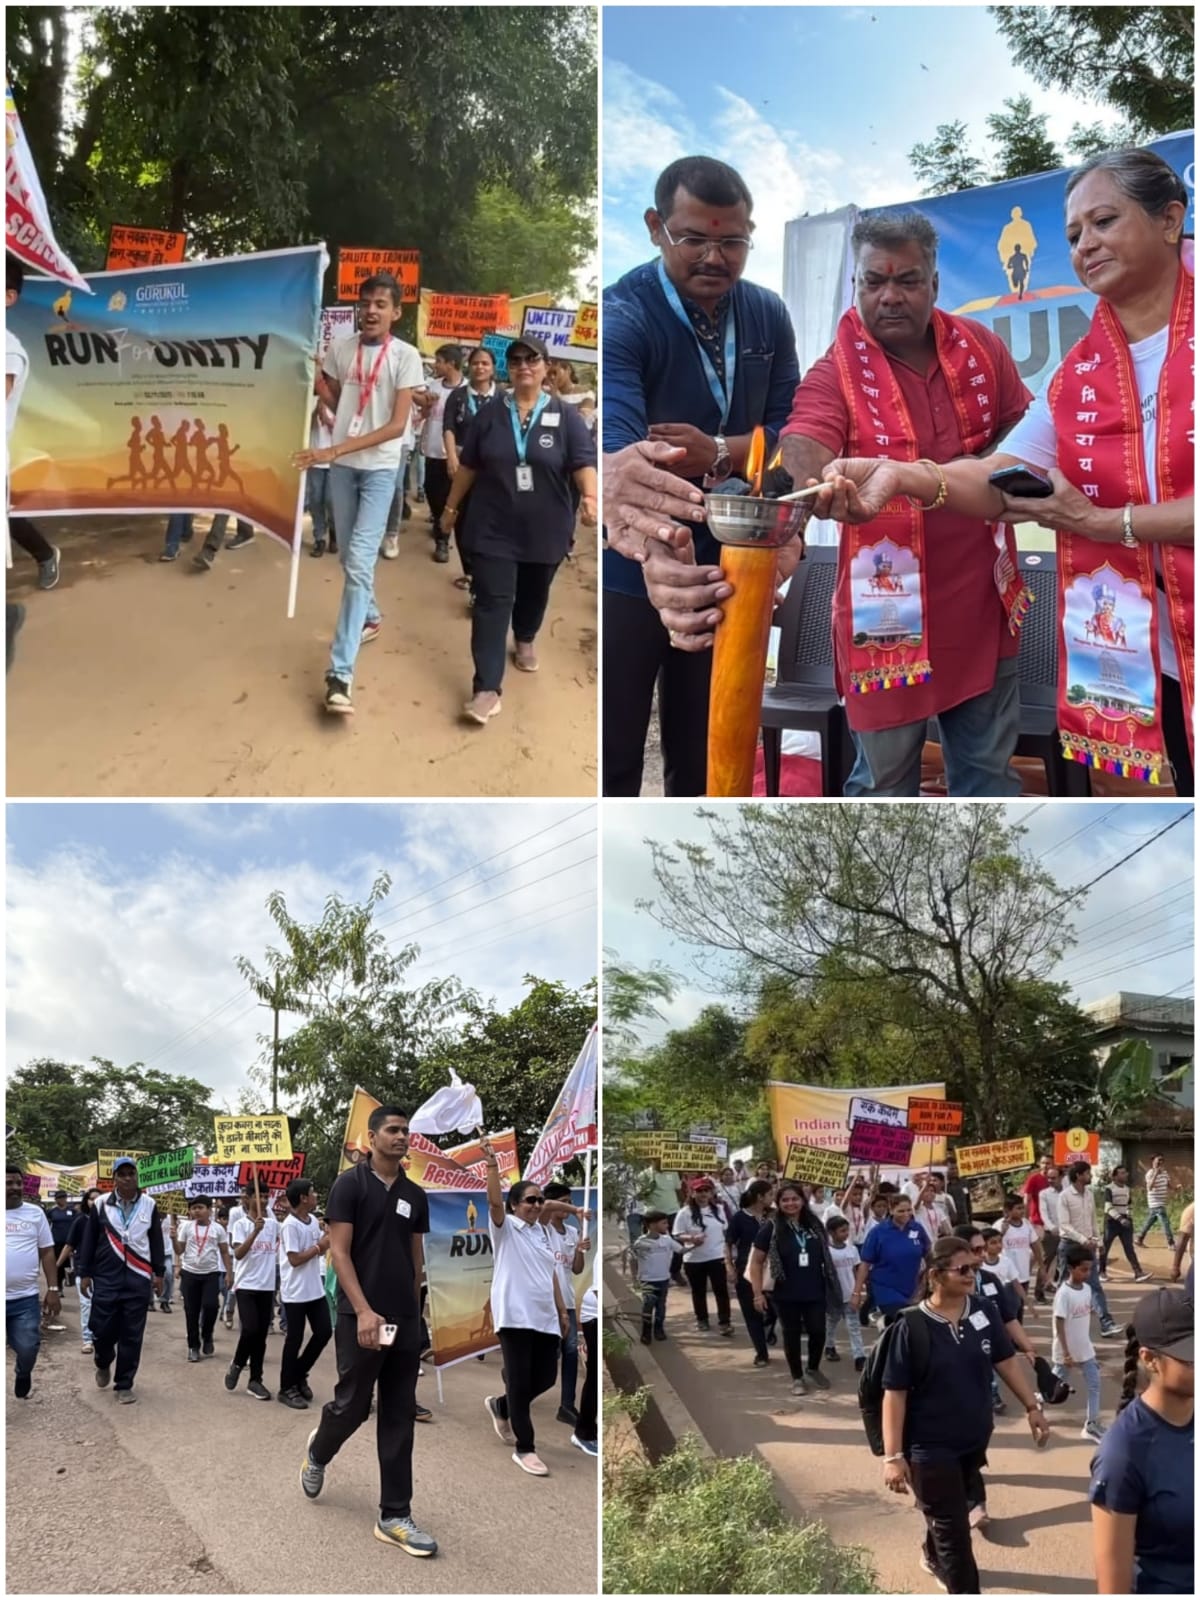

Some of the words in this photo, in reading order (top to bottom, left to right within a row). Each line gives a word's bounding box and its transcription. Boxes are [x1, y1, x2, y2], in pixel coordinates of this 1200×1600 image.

[372, 252, 382, 263] TO
[355, 266, 372, 279] RUN
[395, 267, 404, 279] A
[136, 283, 190, 303] GURUKUL
[341, 284, 360, 296] UNI
[402, 284, 417, 297] ION
[454, 309, 468, 320] FOR
[527, 310, 563, 328] UNITY
[45, 331, 119, 366] RUN
[147, 334, 270, 370] UNITY
[877, 1105, 899, 1119] कदम
[934, 1112, 946, 1120] FOR
[946, 1112, 953, 1120] A
[795, 1119, 841, 1130] Indian
[786, 1135, 851, 1147] Industria
[224, 1145, 236, 1158] तुम
[241, 1144, 250, 1154] ना
[140, 1155, 155, 1169] STEP
[158, 1153, 168, 1165] BY
[168, 1148, 188, 1163] STEP
[139, 1166, 170, 1184] TOGETHER
[246, 1166, 301, 1186] UNITY
[796, 1164, 821, 1175] UNITY
[227, 1176, 242, 1194] ओ
[450, 1233, 494, 1258] RUN
